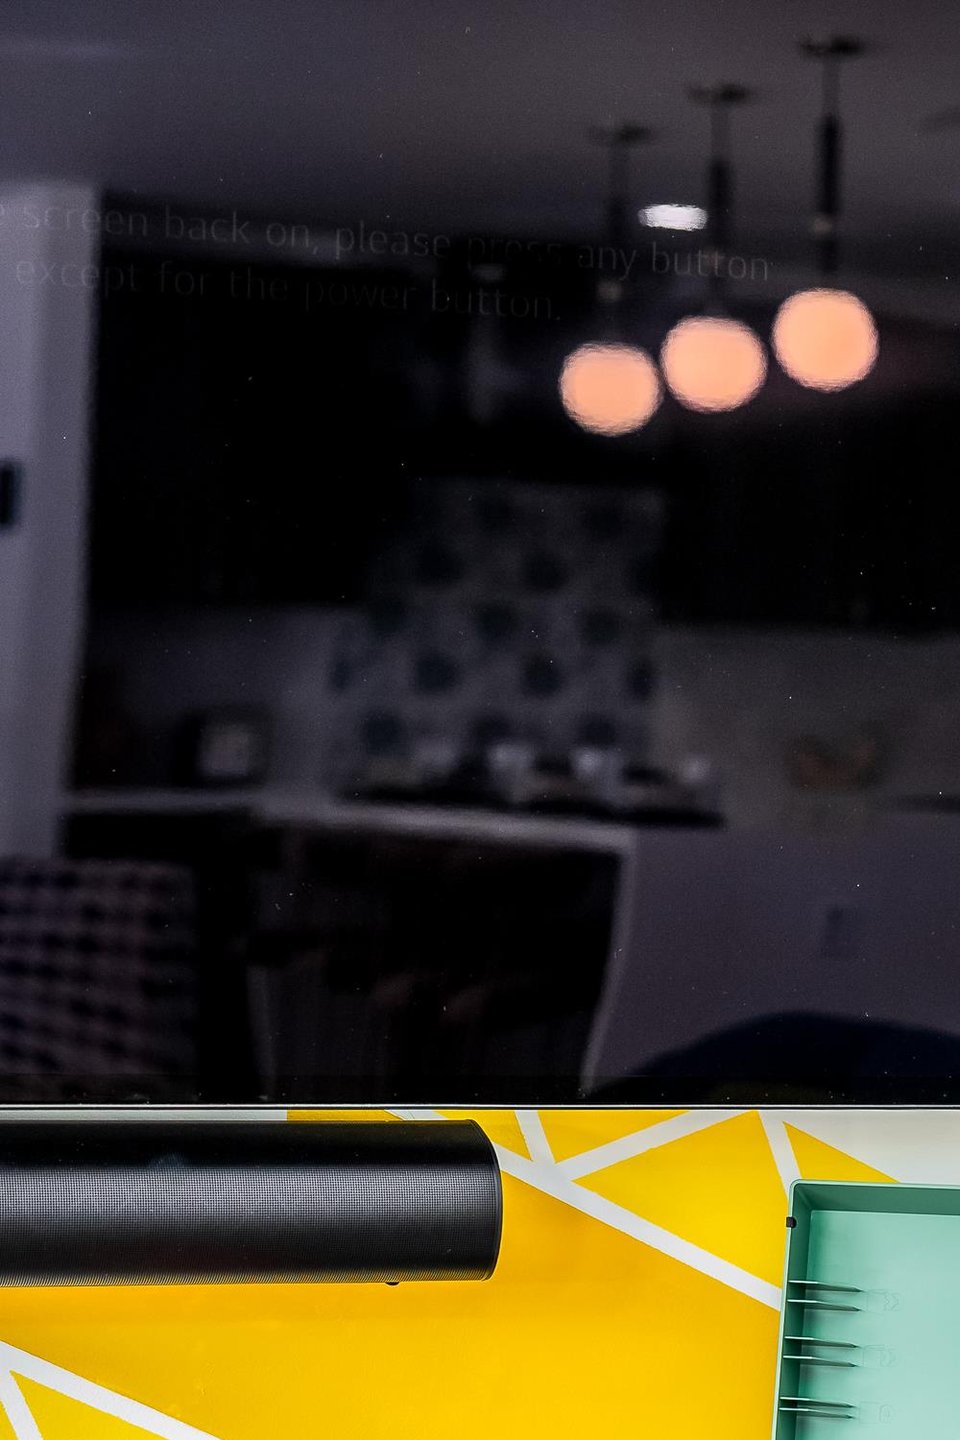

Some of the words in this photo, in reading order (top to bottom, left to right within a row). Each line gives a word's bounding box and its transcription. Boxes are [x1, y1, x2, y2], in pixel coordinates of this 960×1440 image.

[22, 203, 149, 237] screen
[163, 204, 251, 245] back
[264, 220, 320, 255] on,
[334, 219, 452, 261] please
[577, 243, 637, 281] any
[651, 242, 770, 281] button
[16, 260, 143, 298] except
[157, 260, 212, 297] for
[229, 266, 289, 301] the
[304, 280, 418, 313] power
[430, 278, 562, 321] button.
